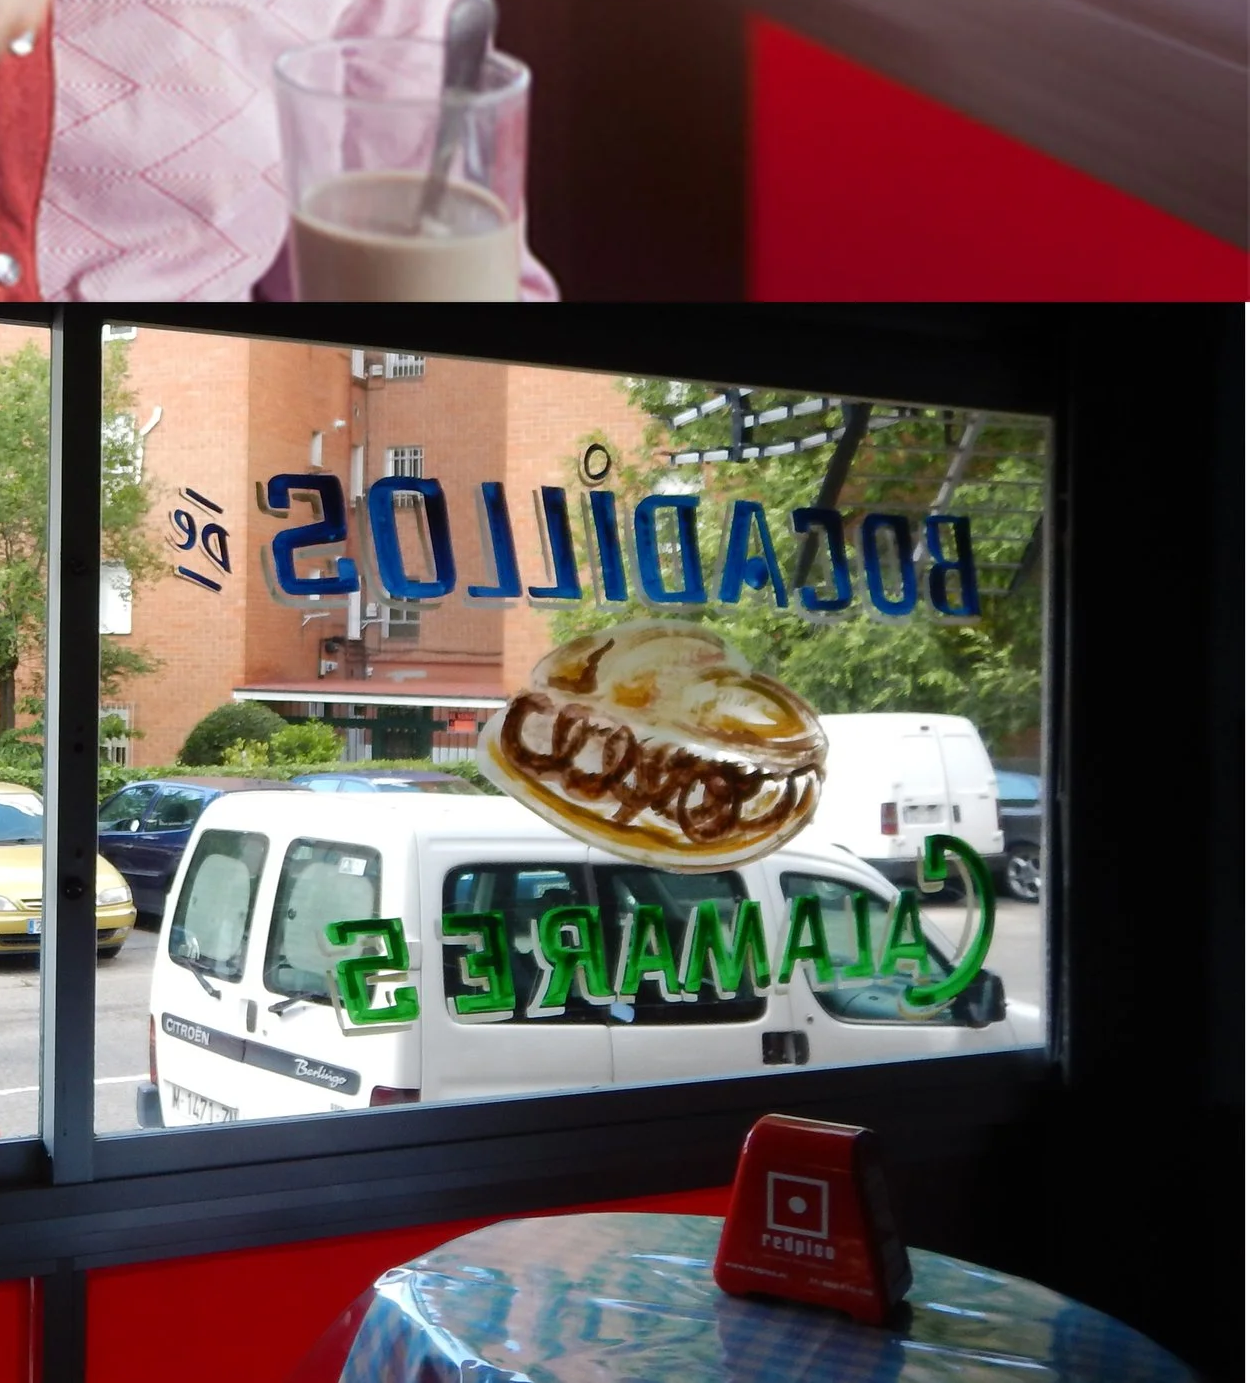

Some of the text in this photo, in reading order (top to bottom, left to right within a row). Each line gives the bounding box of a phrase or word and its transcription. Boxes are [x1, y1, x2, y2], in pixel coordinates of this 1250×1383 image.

[165, 1017, 210, 1046] CITROËN
[293, 1059, 348, 1088] Berlingo
[761, 1233, 836, 1260] redpiso
